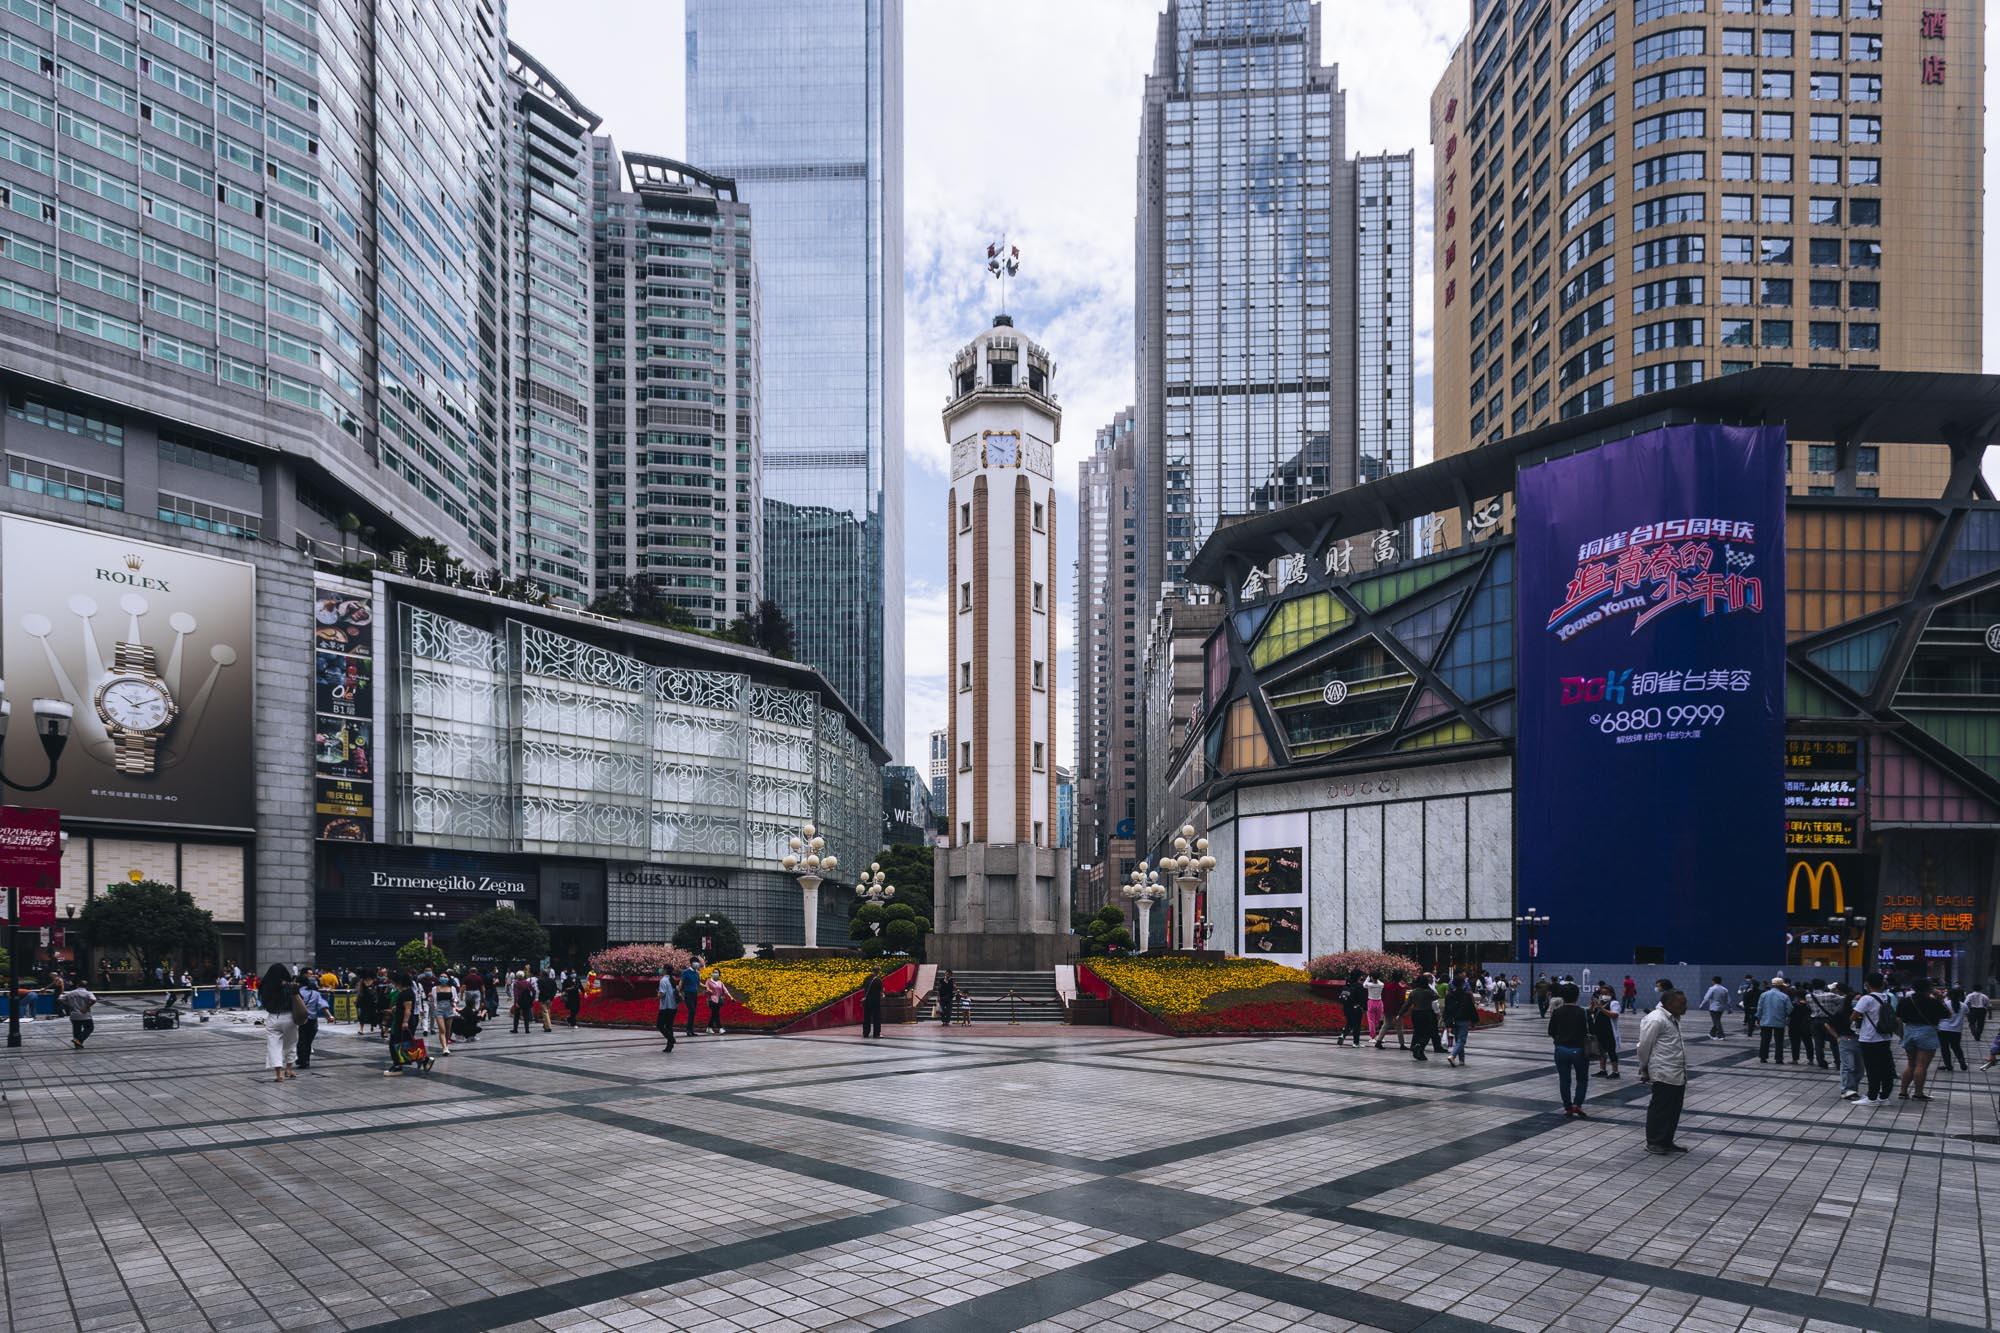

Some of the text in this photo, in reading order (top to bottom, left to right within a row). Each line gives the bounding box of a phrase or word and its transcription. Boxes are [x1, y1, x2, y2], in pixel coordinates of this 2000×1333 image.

[1920, 10, 1946, 85] 酒店
[1240, 504, 1501, 600] 金鹰财富中心
[1578, 518, 1755, 563] 铜雀台15周年庆
[96, 568, 171, 592] ROLEX
[390, 551, 540, 600] 重庆时代广场
[1547, 541, 1713, 630] 追青春的
[1556, 595, 1646, 641] YOUNG YOUTH
[1631, 668, 1751, 696] 铜雀台美容
[1600, 704, 1725, 734] 6880 9999
[894, 807, 920, 825] WFC
[371, 872, 525, 895] Ermenegildo Zegna
[618, 871, 729, 889] LOUIS VUITTON
[330, 938, 396, 947] Ermenegildo Zegna
[1425, 927, 1467, 937] GUCCI
